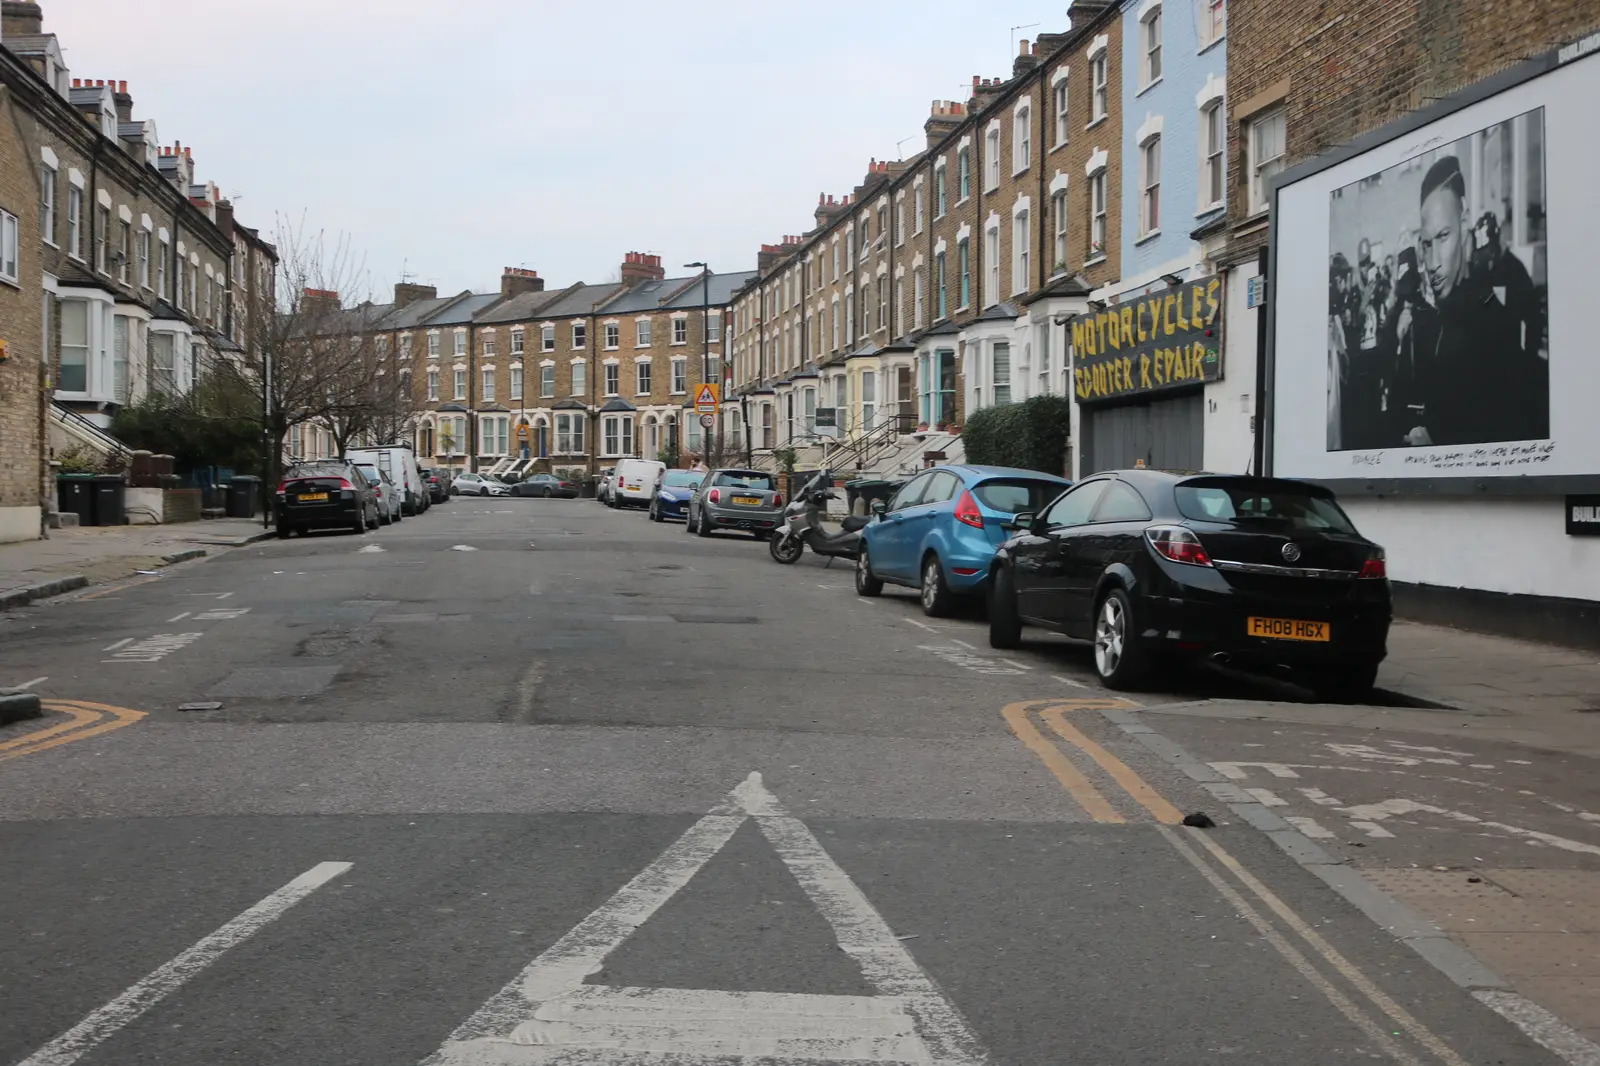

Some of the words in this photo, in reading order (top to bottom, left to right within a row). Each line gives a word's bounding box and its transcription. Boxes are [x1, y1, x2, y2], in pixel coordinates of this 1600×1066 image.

[1072, 278, 1220, 360] MOTORCYCLES
[1075, 356, 1134, 399] SCOOTER
[1253, 618, 1292, 635] FH08
[1295, 621, 1324, 638] HGX
